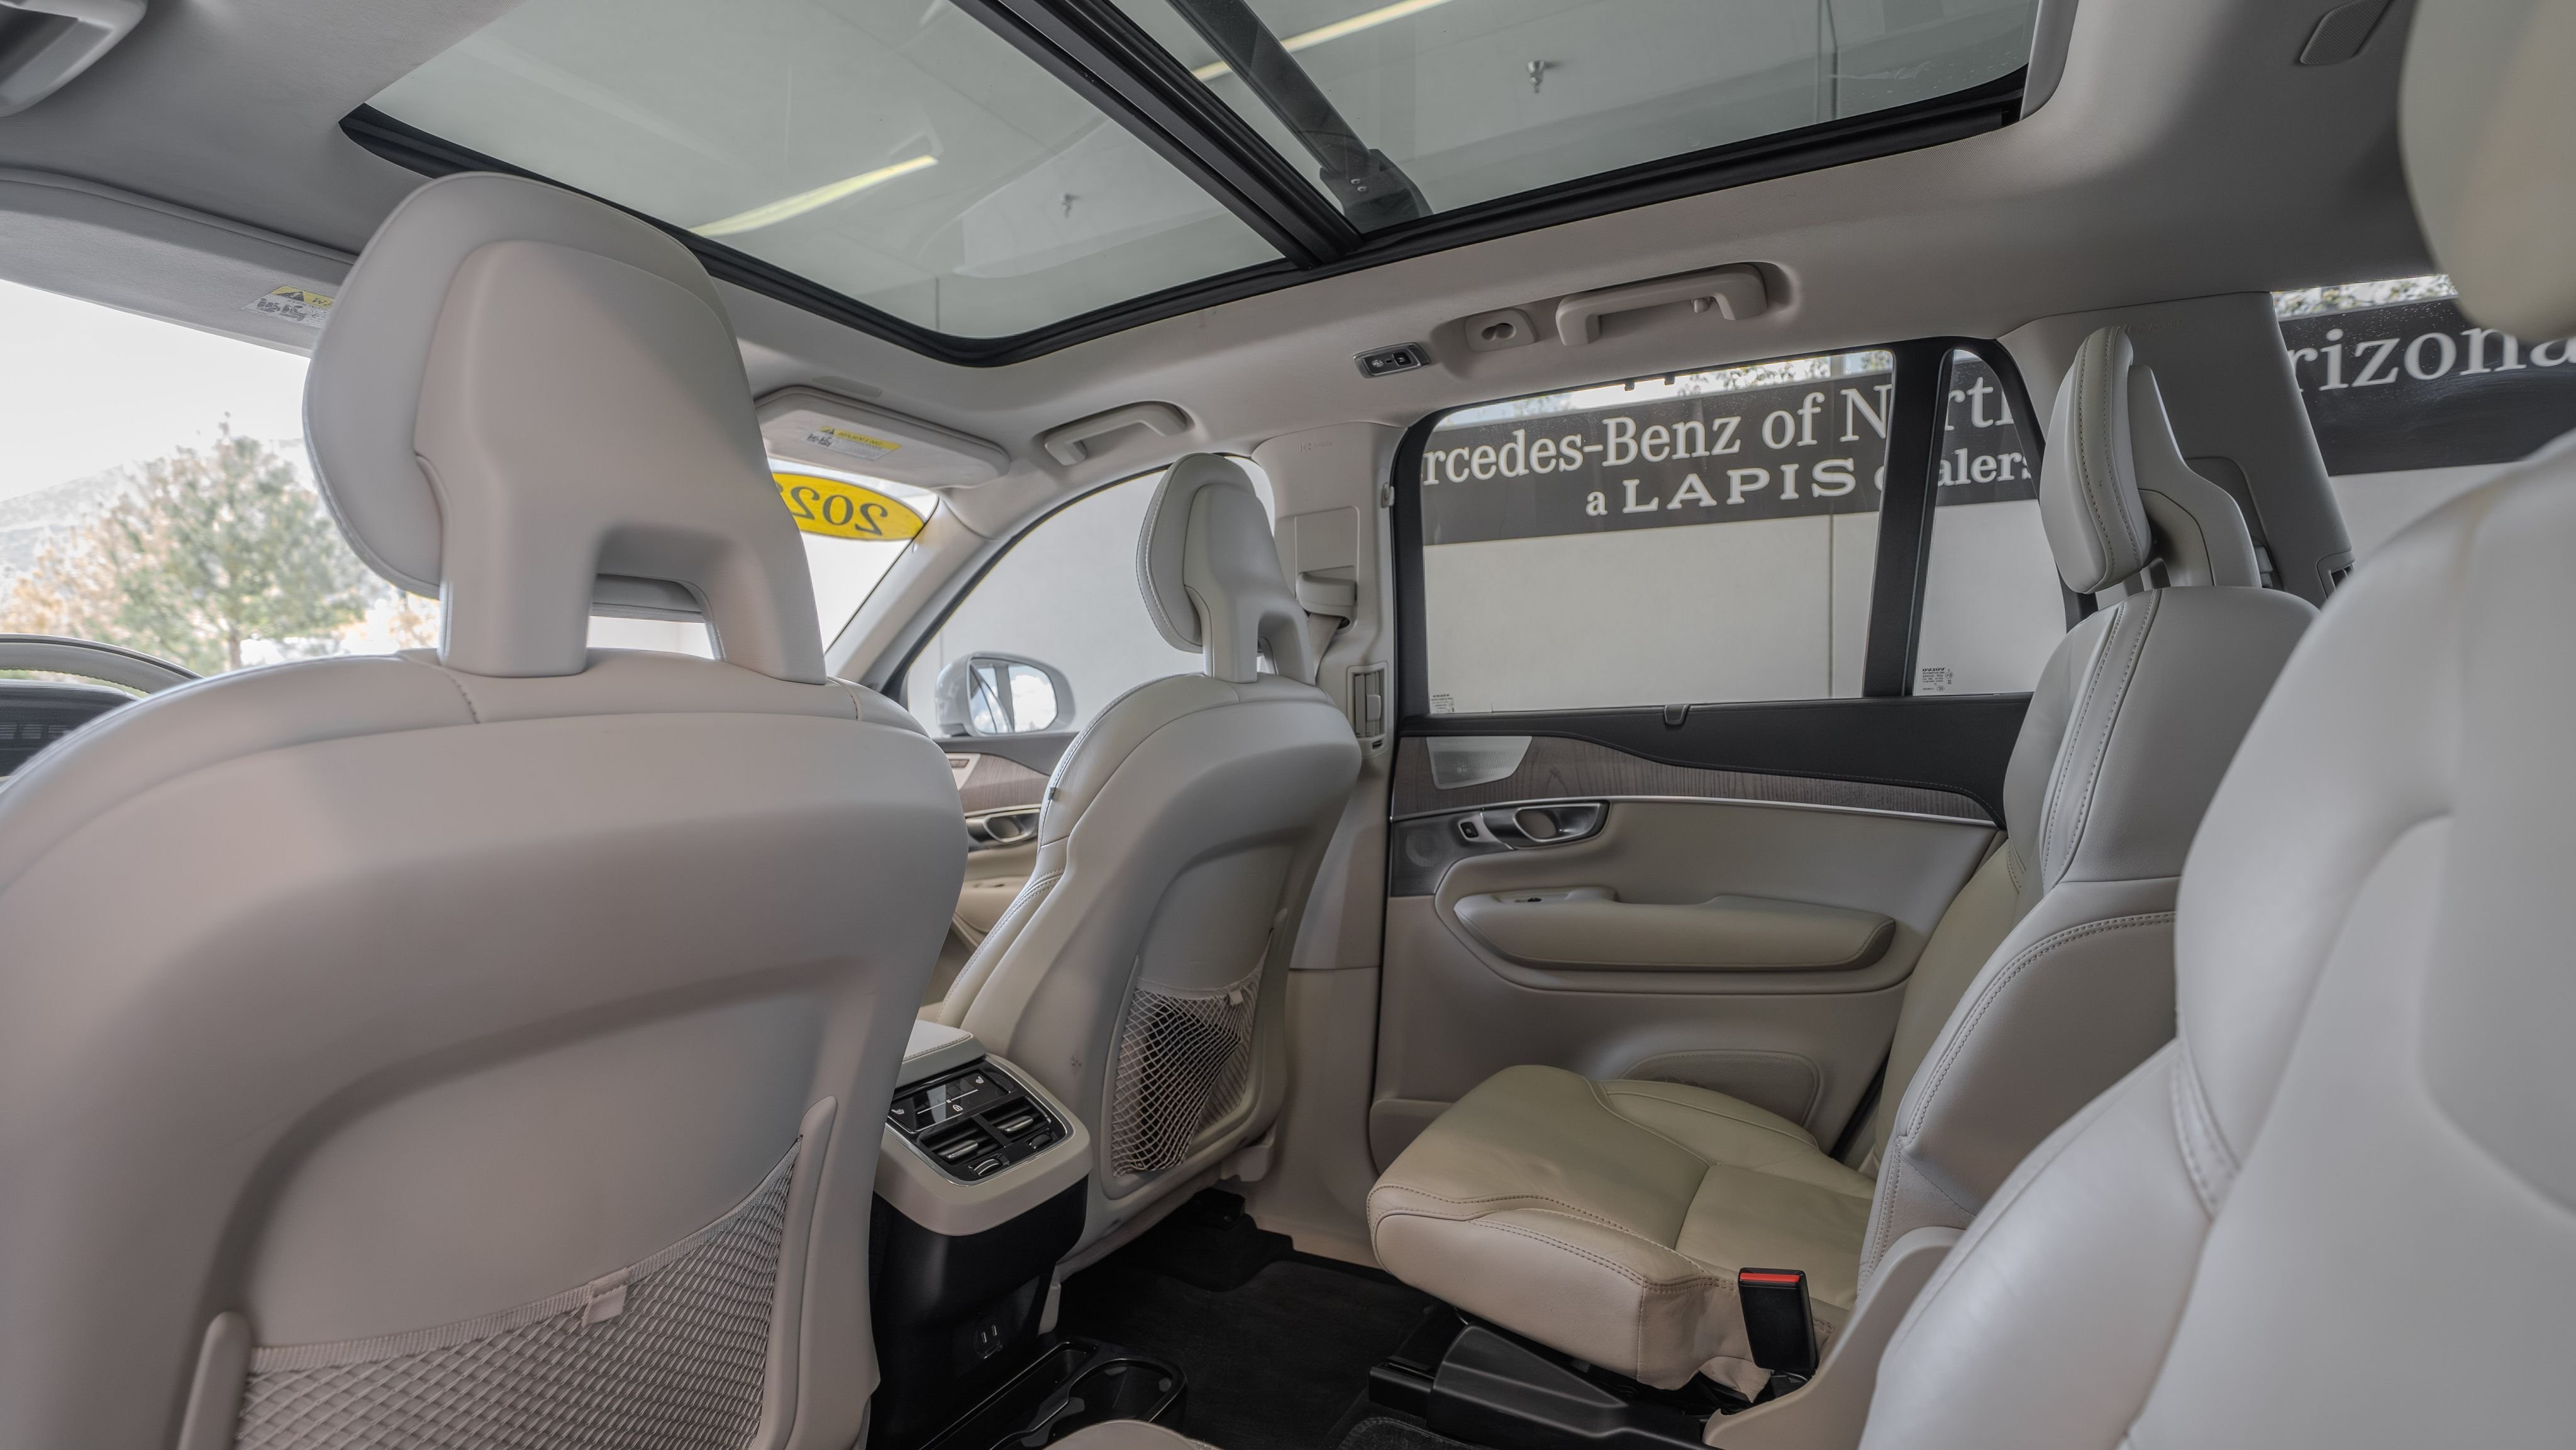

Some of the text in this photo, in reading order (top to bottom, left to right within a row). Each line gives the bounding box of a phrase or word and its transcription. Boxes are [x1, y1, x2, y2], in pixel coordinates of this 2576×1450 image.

[1762, 392, 1825, 449] of
[1585, 491, 1607, 516] a
[1622, 458, 1856, 514] LAPIS
